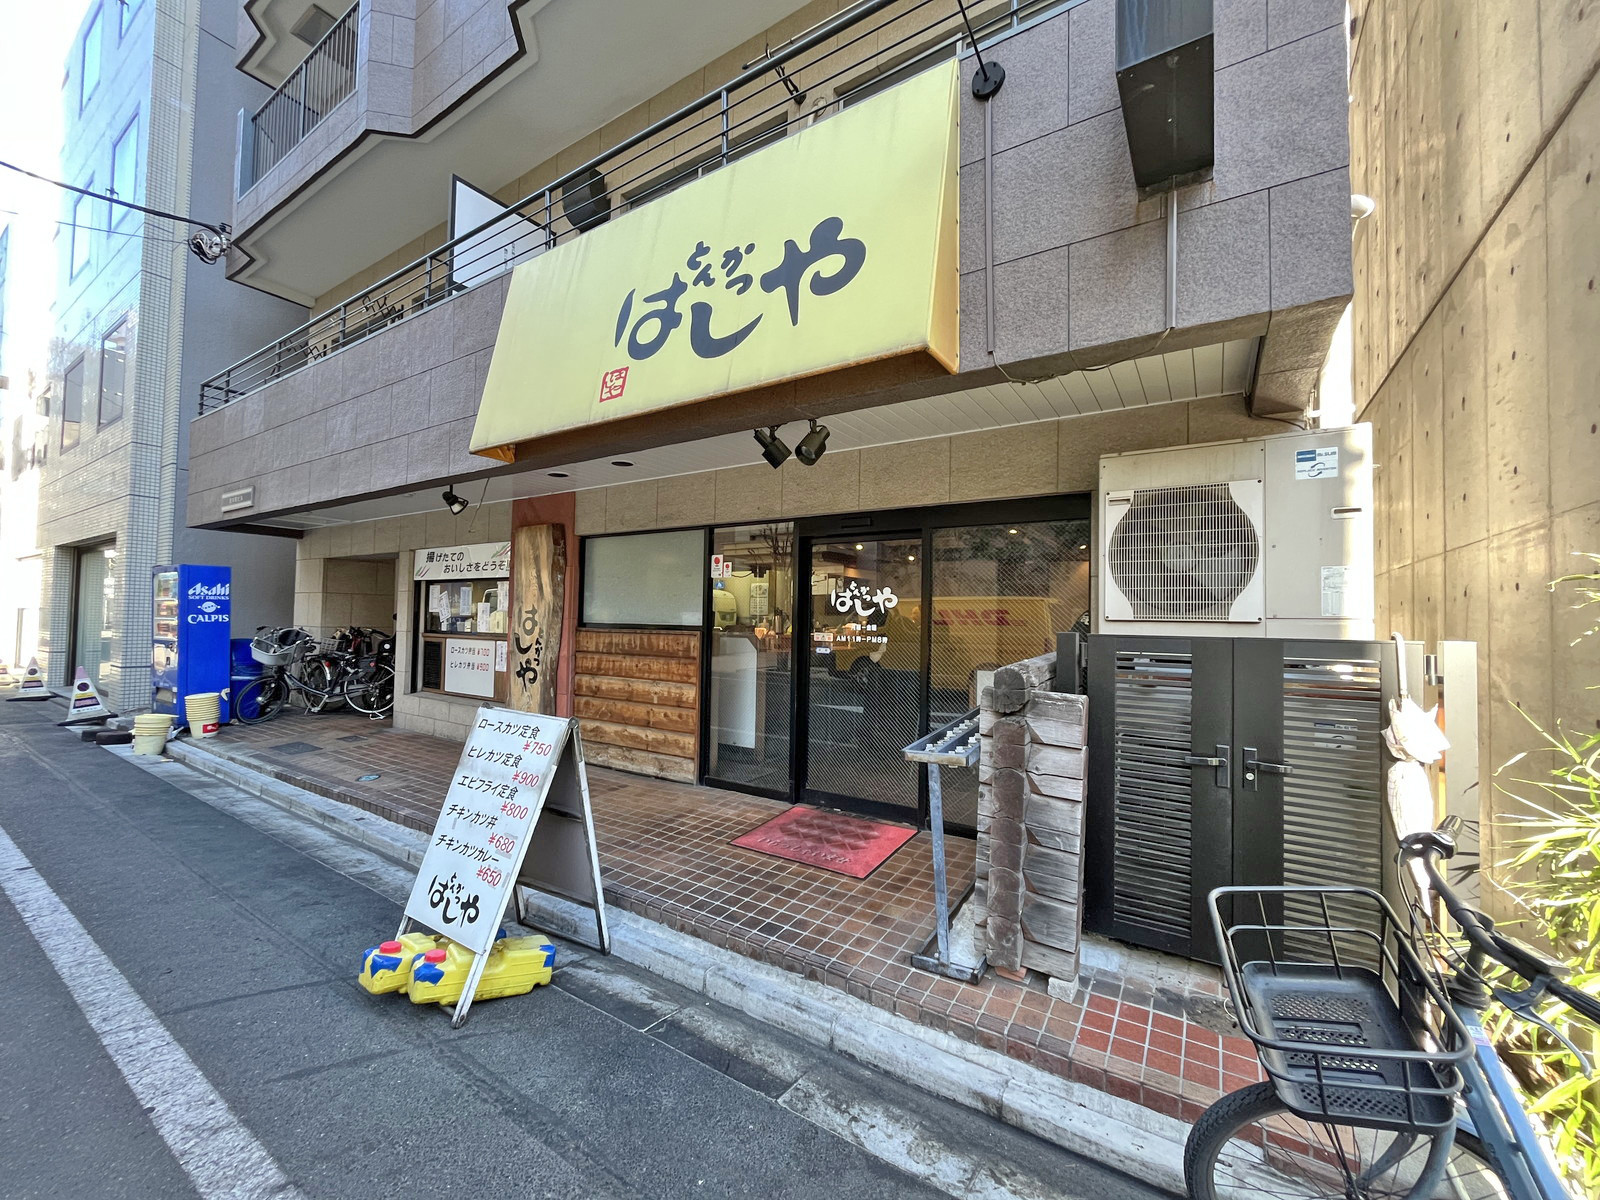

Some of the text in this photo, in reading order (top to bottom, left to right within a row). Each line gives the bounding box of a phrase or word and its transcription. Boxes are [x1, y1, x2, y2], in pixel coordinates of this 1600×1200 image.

[686, 240, 756, 296] とんかつ
[614, 216, 867, 361] はしや
[425, 551, 465, 563] 揚げたての
[187, 582, 230, 596] Asahi
[830, 586, 898, 617] はしや
[187, 614, 230, 625] CALPIS
[477, 718, 541, 740] ロースカツ定食
[467, 745, 523, 769] ヒレカツ定食
[522, 740, 553, 757] ¥750
[512, 770, 540, 788] ¥900
[500, 800, 529, 820] ¥800
[435, 834, 500, 863] チキンカツカレー
[487, 832, 515, 854] ¥680
[475, 864, 502, 887] ¥650
[427, 874, 480, 928] はしや
